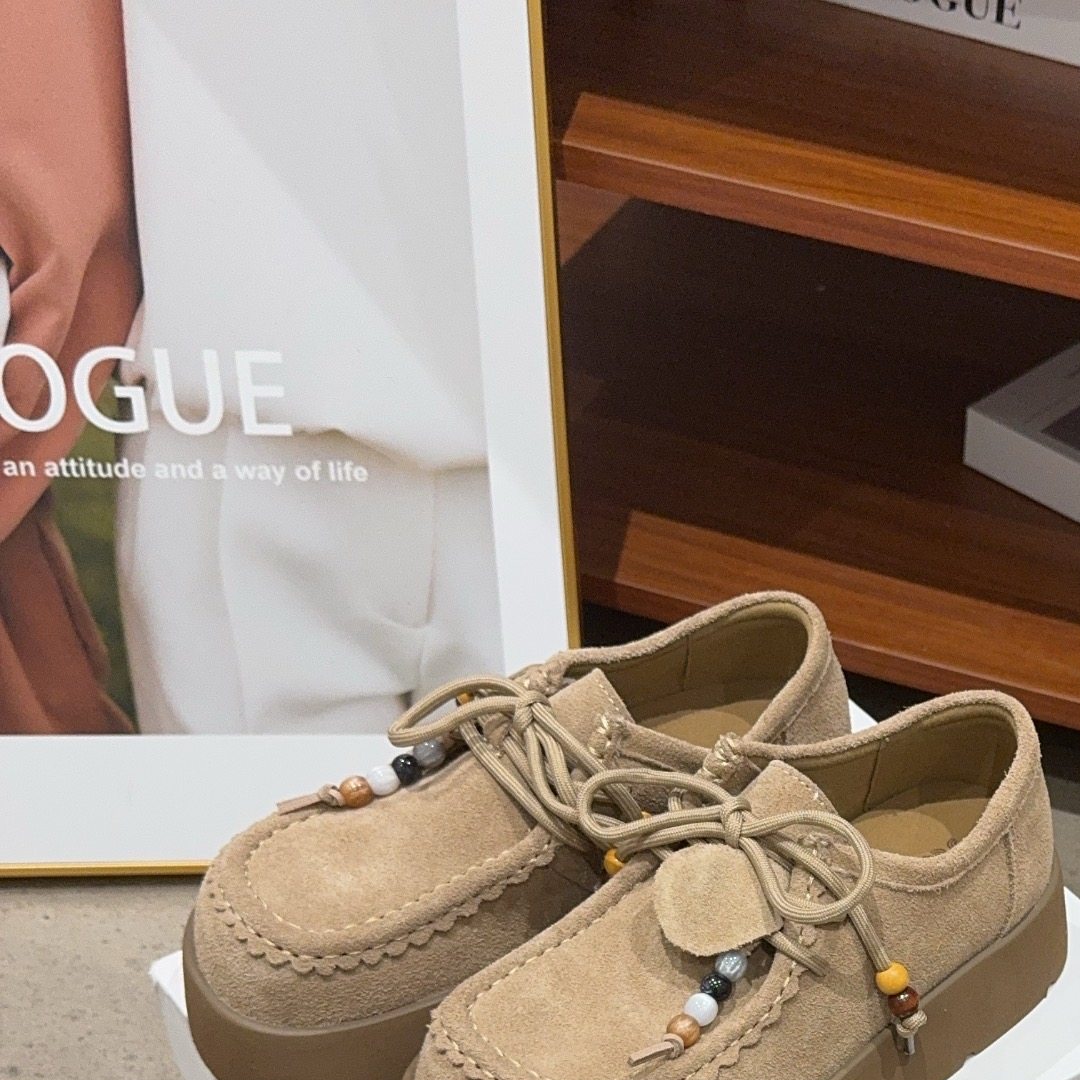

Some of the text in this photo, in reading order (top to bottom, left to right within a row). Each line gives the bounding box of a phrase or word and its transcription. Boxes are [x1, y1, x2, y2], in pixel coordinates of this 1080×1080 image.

[906, 0, 1021, 29] UE
[3, 457, 369, 486] an attitude and a way of life
